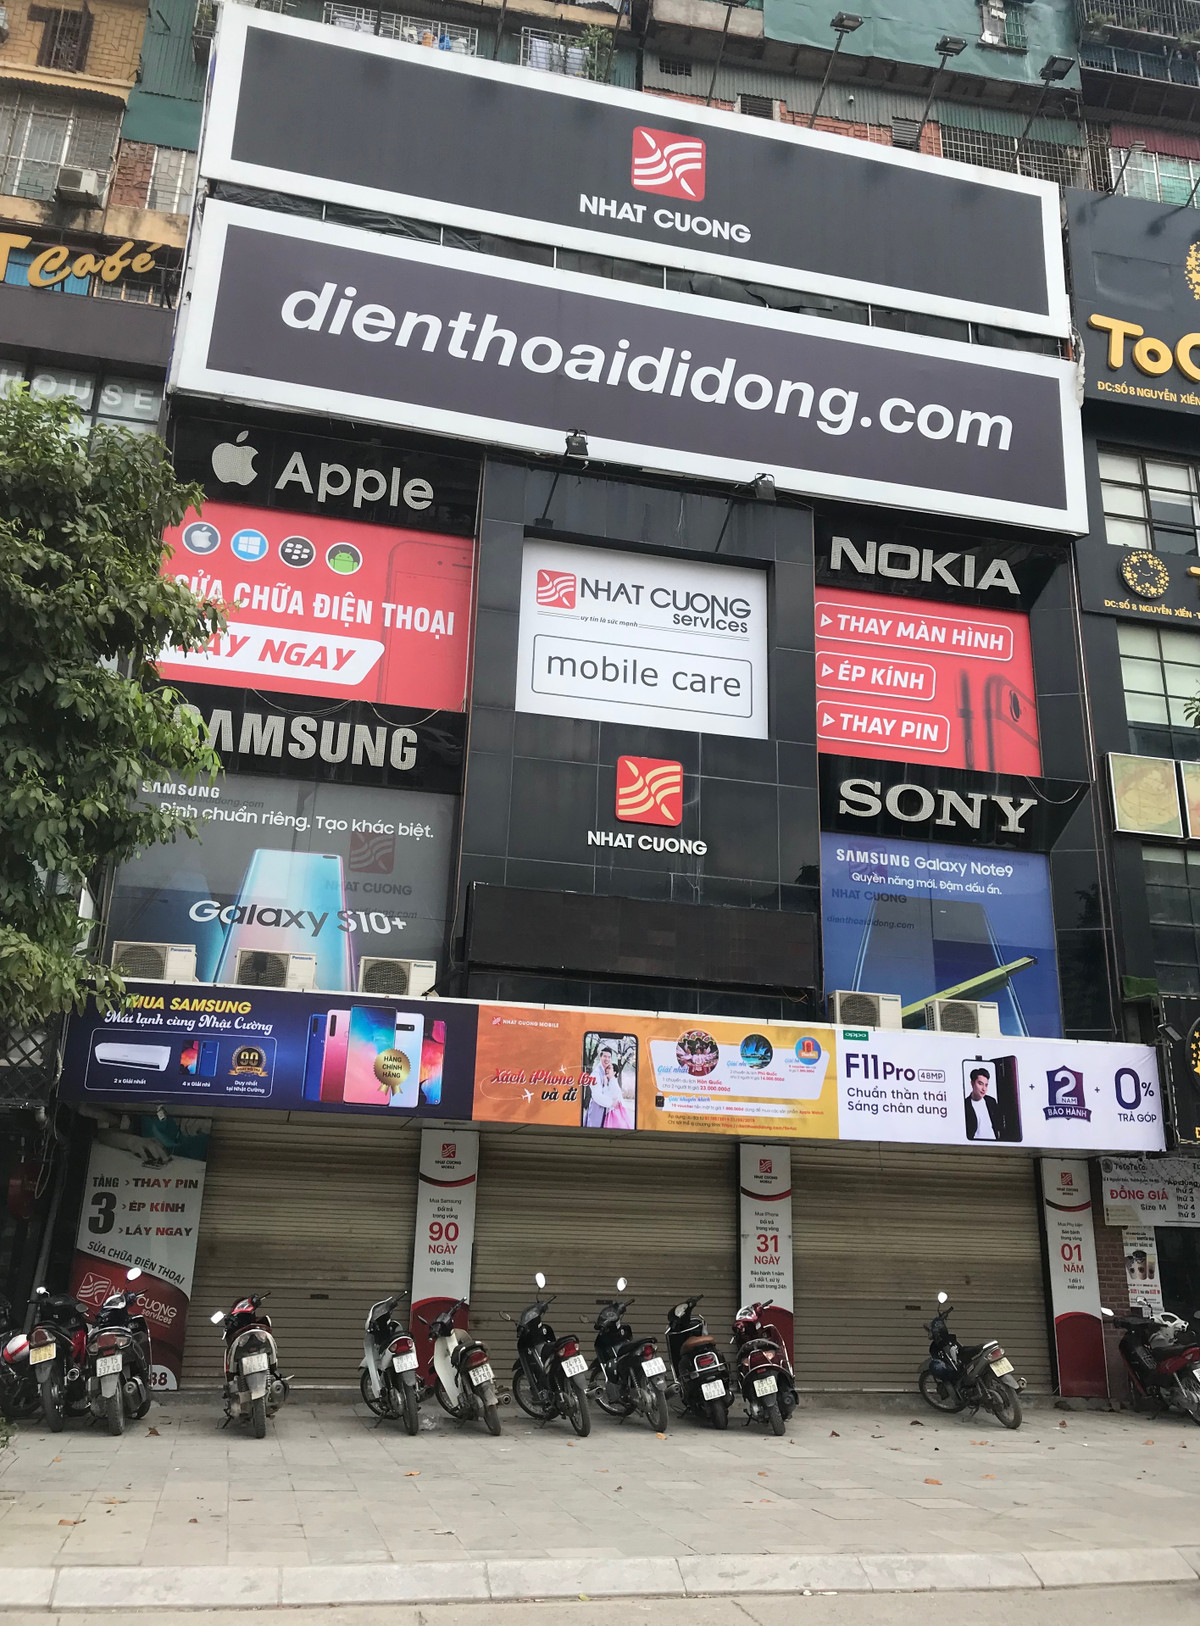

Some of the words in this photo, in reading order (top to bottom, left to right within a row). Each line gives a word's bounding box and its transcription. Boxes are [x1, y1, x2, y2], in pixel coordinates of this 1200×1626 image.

[580, 193, 647, 224] NHAT
[653, 209, 752, 243] CUONG
[27, 241, 163, 287] Café
[281, 281, 1014, 451] dienthoaididong.com
[1136, 388, 1177, 402] NGUYỄN
[274, 451, 434, 510] Apple
[830, 536, 1021, 595] NOKIA
[580, 578, 645, 606] NHAT
[650, 588, 752, 620] CUONG
[232, 582, 305, 616] CHỮA
[312, 592, 373, 627] ĐIỆN
[381, 602, 454, 640] THOẠI
[600, 616, 606, 624] là
[672, 612, 748, 634] services
[837, 614, 892, 636] THAY
[896, 621, 946, 644] MÀN
[951, 627, 1004, 651] HÌNH
[258, 638, 357, 671] NGAY
[547, 656, 659, 688] mobile
[672, 670, 741, 697] care
[838, 660, 866, 682] ÉP
[870, 666, 924, 690] KÍNH
[840, 713, 897, 735] THAY
[900, 722, 938, 742] PIN
[839, 778, 1038, 834] SONY
[202, 805, 258, 824] chuẩn
[262, 810, 310, 832] riêng.
[316, 816, 348, 834] Tạo
[352, 819, 395, 835] khác
[398, 822, 434, 840] biệt.
[587, 831, 635, 849] NHAT
[638, 835, 708, 856] CUONG
[836, 848, 910, 868] SAMSUNG
[914, 857, 967, 877] Galaxy
[970, 862, 1014, 878] Note9
[362, 882, 413, 896] CUONG
[852, 872, 886, 886] Quyền
[888, 876, 914, 890] năng
[916, 879, 938, 889] mới.
[939, 881, 964, 892] Đậm
[965, 882, 985, 893] dấu
[986, 883, 1002, 895] ấn.
[831, 888, 861, 899] NHAT
[864, 891, 908, 904] CUONG
[188, 900, 329, 937] Galaxy
[337, 910, 407, 934] S10+
[170, 998, 252, 1015] SAMSUNG
[136, 1012, 164, 1026] lạnh
[166, 1016, 196, 1032] cùng
[198, 1015, 232, 1032] Nhật
[234, 1017, 274, 1036] Cường
[846, 1053, 878, 1080] F11
[883, 1062, 916, 1082] Pro
[920, 1072, 943, 1080] 48MP
[541, 1088, 560, 1102] và
[846, 1086, 887, 1099] Chuẩn
[891, 1087, 919, 1100] thần
[923, 1090, 947, 1102] thái
[1054, 1070, 1076, 1104] 2
[848, 1100, 879, 1115] Sáng
[882, 1102, 913, 1114] chân
[916, 1104, 948, 1118] dung
[1118, 1111, 1136, 1122] TRẢ
[1136, 1112, 1157, 1123] GÓP
[132, 1178, 172, 1188] THAY
[176, 1179, 199, 1189] PIN
[1148, 1188, 1169, 1200] GIÁ
[88, 1192, 117, 1234] 3
[128, 1200, 146, 1212] ÉP
[150, 1201, 186, 1213] KÍNH
[156, 1227, 193, 1237] NGAY
[428, 1222, 460, 1242] 90
[756, 1234, 778, 1253] 31
[428, 1243, 458, 1255] NGÀY
[754, 1254, 781, 1265] NGÀY
[1061, 1243, 1082, 1262] 01
[87, 1241, 106, 1254] SỬA
[107, 1249, 132, 1262] CHỮA
[134, 1257, 158, 1272] ĐIỆN
[158, 1266, 186, 1285] THOẠI
[1063, 1263, 1085, 1273] NĂM
[136, 1296, 178, 1318] CUONG
